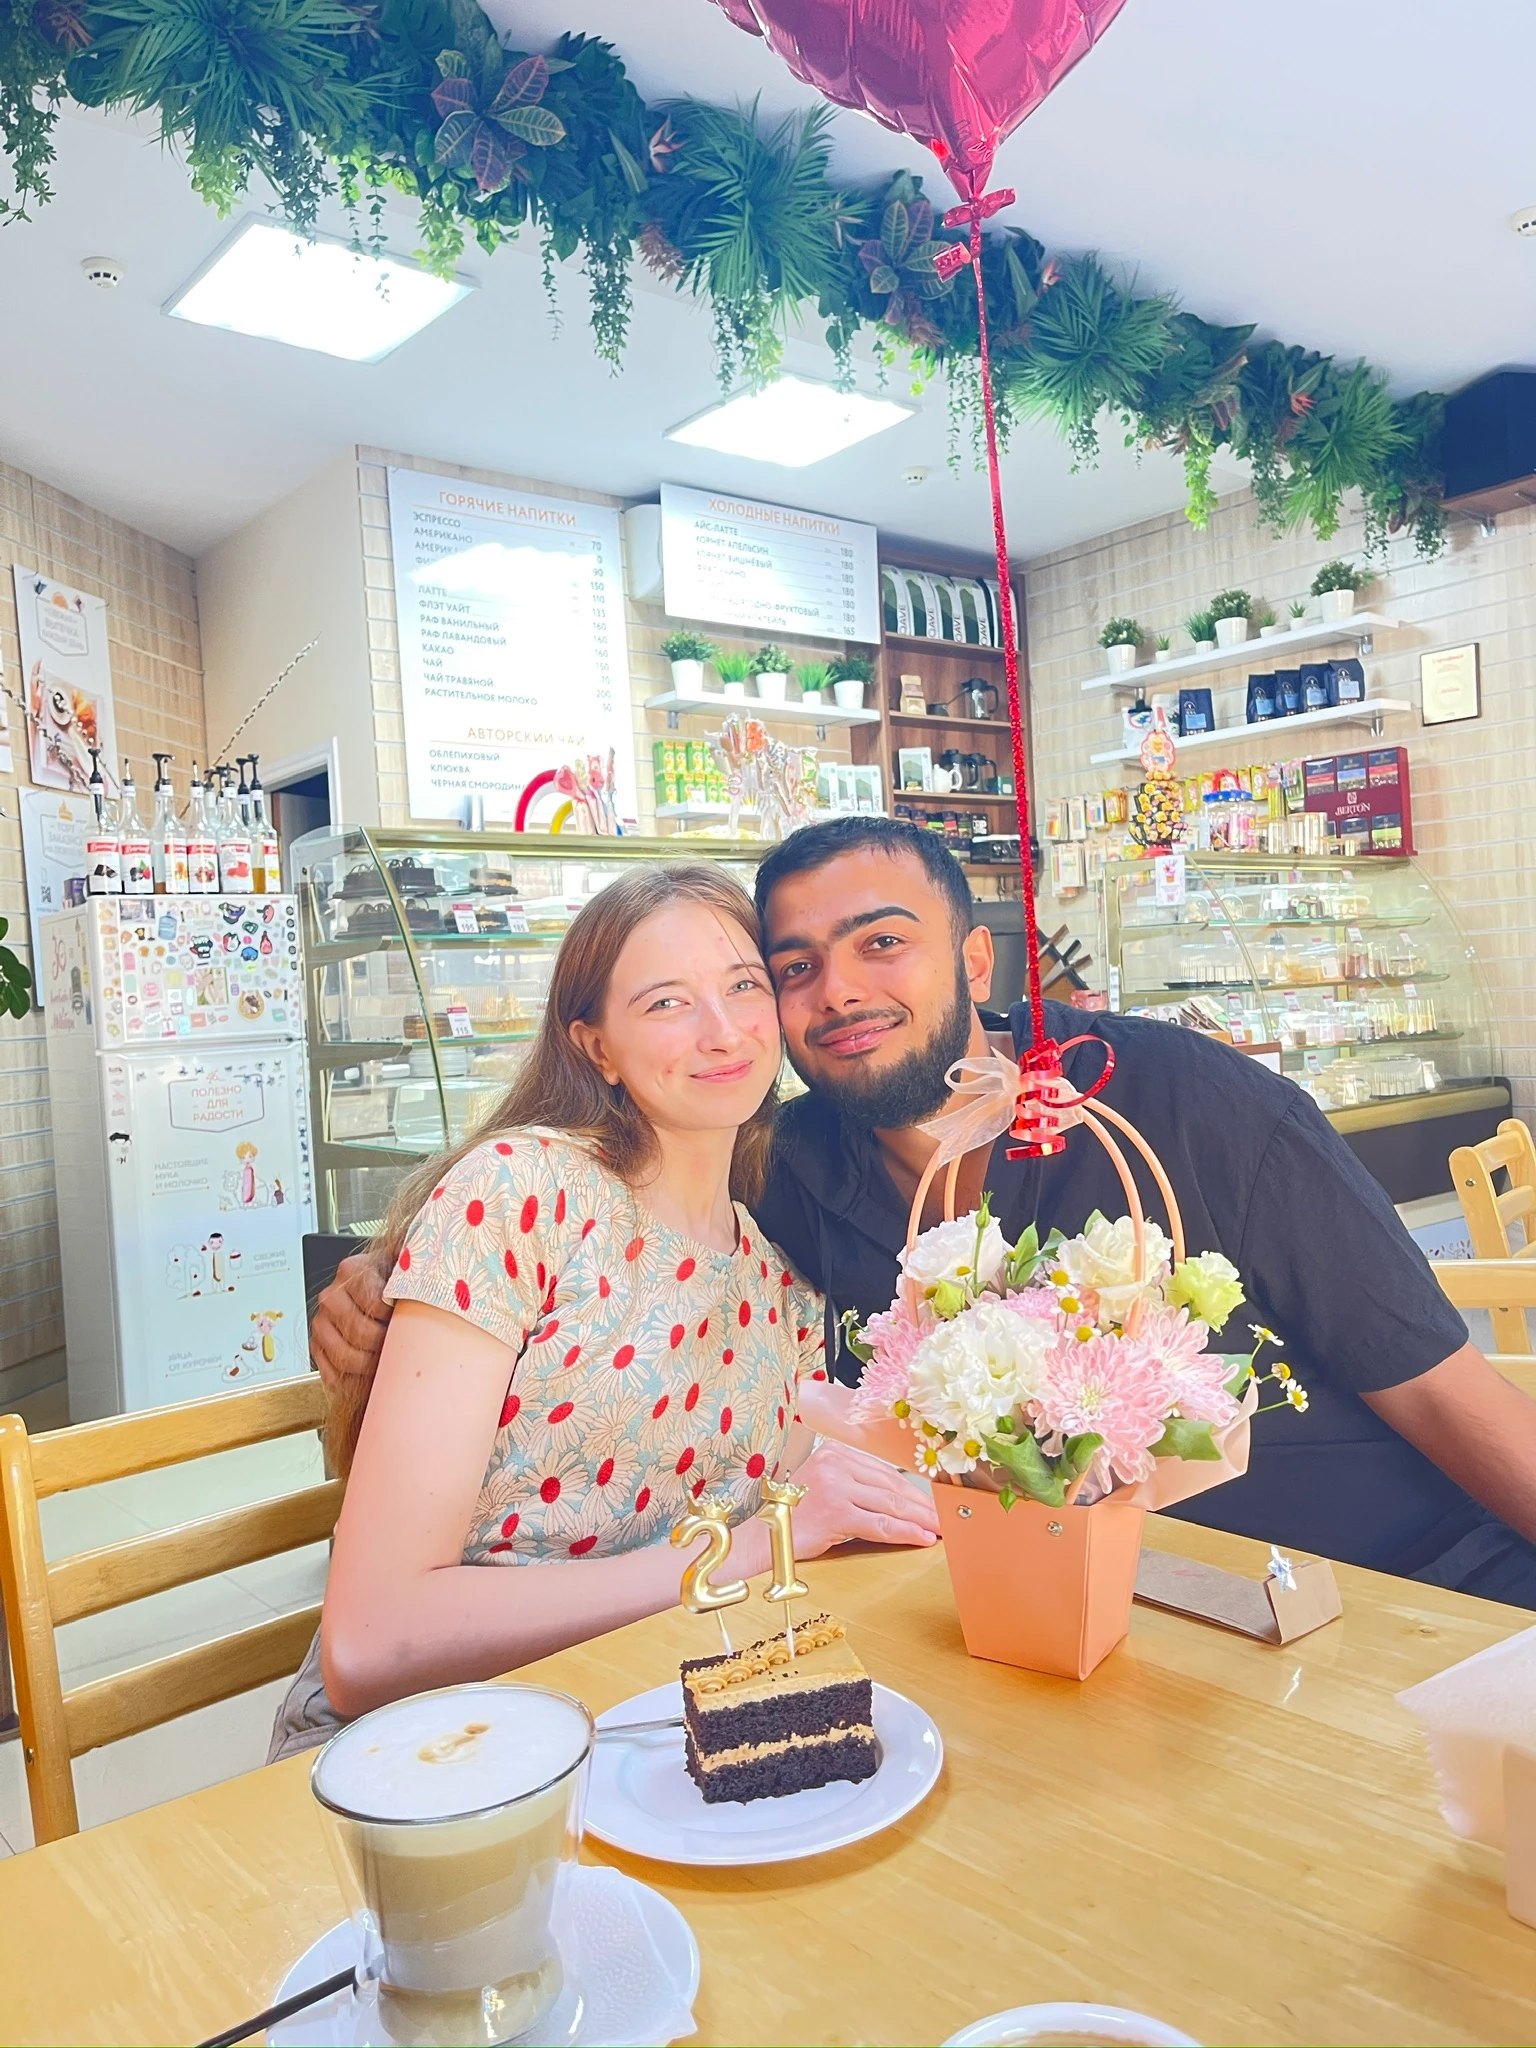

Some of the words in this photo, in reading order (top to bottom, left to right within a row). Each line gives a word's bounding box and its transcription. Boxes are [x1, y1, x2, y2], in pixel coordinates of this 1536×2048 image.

[439, 491, 504, 514] ГОРЯЧИЕ
[507, 504, 576, 527] НАПИТКИ
[709, 498, 780, 524] ХОЛОДНЫЕ
[783, 512, 840, 535] НАПИТКИ
[412, 511, 461, 527] ЭСПРЕССО
[591, 541, 602, 550] 70
[414, 527, 473, 543] АМЕРИКАНО
[727, 541, 769, 555] АПЕЛЬСИН
[841, 561, 854, 570] 180
[840, 547, 853, 558] 180
[841, 574, 854, 584] 180
[419, 585, 447, 597] ЛАТТЕ
[591, 581, 604, 591] 150
[842, 587, 854, 597] 180
[419, 600, 444, 611] ФЛЭТ
[446, 602, 471, 614] УАЙТ
[842, 600, 855, 610] 180
[420, 614, 439, 624] РАФ
[441, 617, 499, 631] ВАНИЛЬНЫЙ
[843, 612, 855, 623] 180
[421, 628, 440, 638] РАФ
[442, 631, 507, 646] ЛАВАНДОВЫЙ
[843, 626, 855, 636] 165
[422, 643, 454, 655] КАКАО
[422, 658, 443, 668] ЧАЙ
[423, 672, 443, 683] ЧАЙ
[445, 675, 494, 687] ТРАВЯНОЙ
[424, 687, 495, 702] РАСТИТЕЛЬНОЕ
[498, 695, 538, 706] МОЛОКО
[429, 749, 500, 761] ОБЛЕПИХОВЫЙ
[431, 764, 470, 774] КЛЮКВА
[431, 779, 467, 788] ЧЕРНАЯ
[191, 1085, 242, 1098] ПОЛЕЗНО
[207, 1098, 228, 1109] ДЛЯ
[193, 1109, 244, 1122] РАДОСТИ
